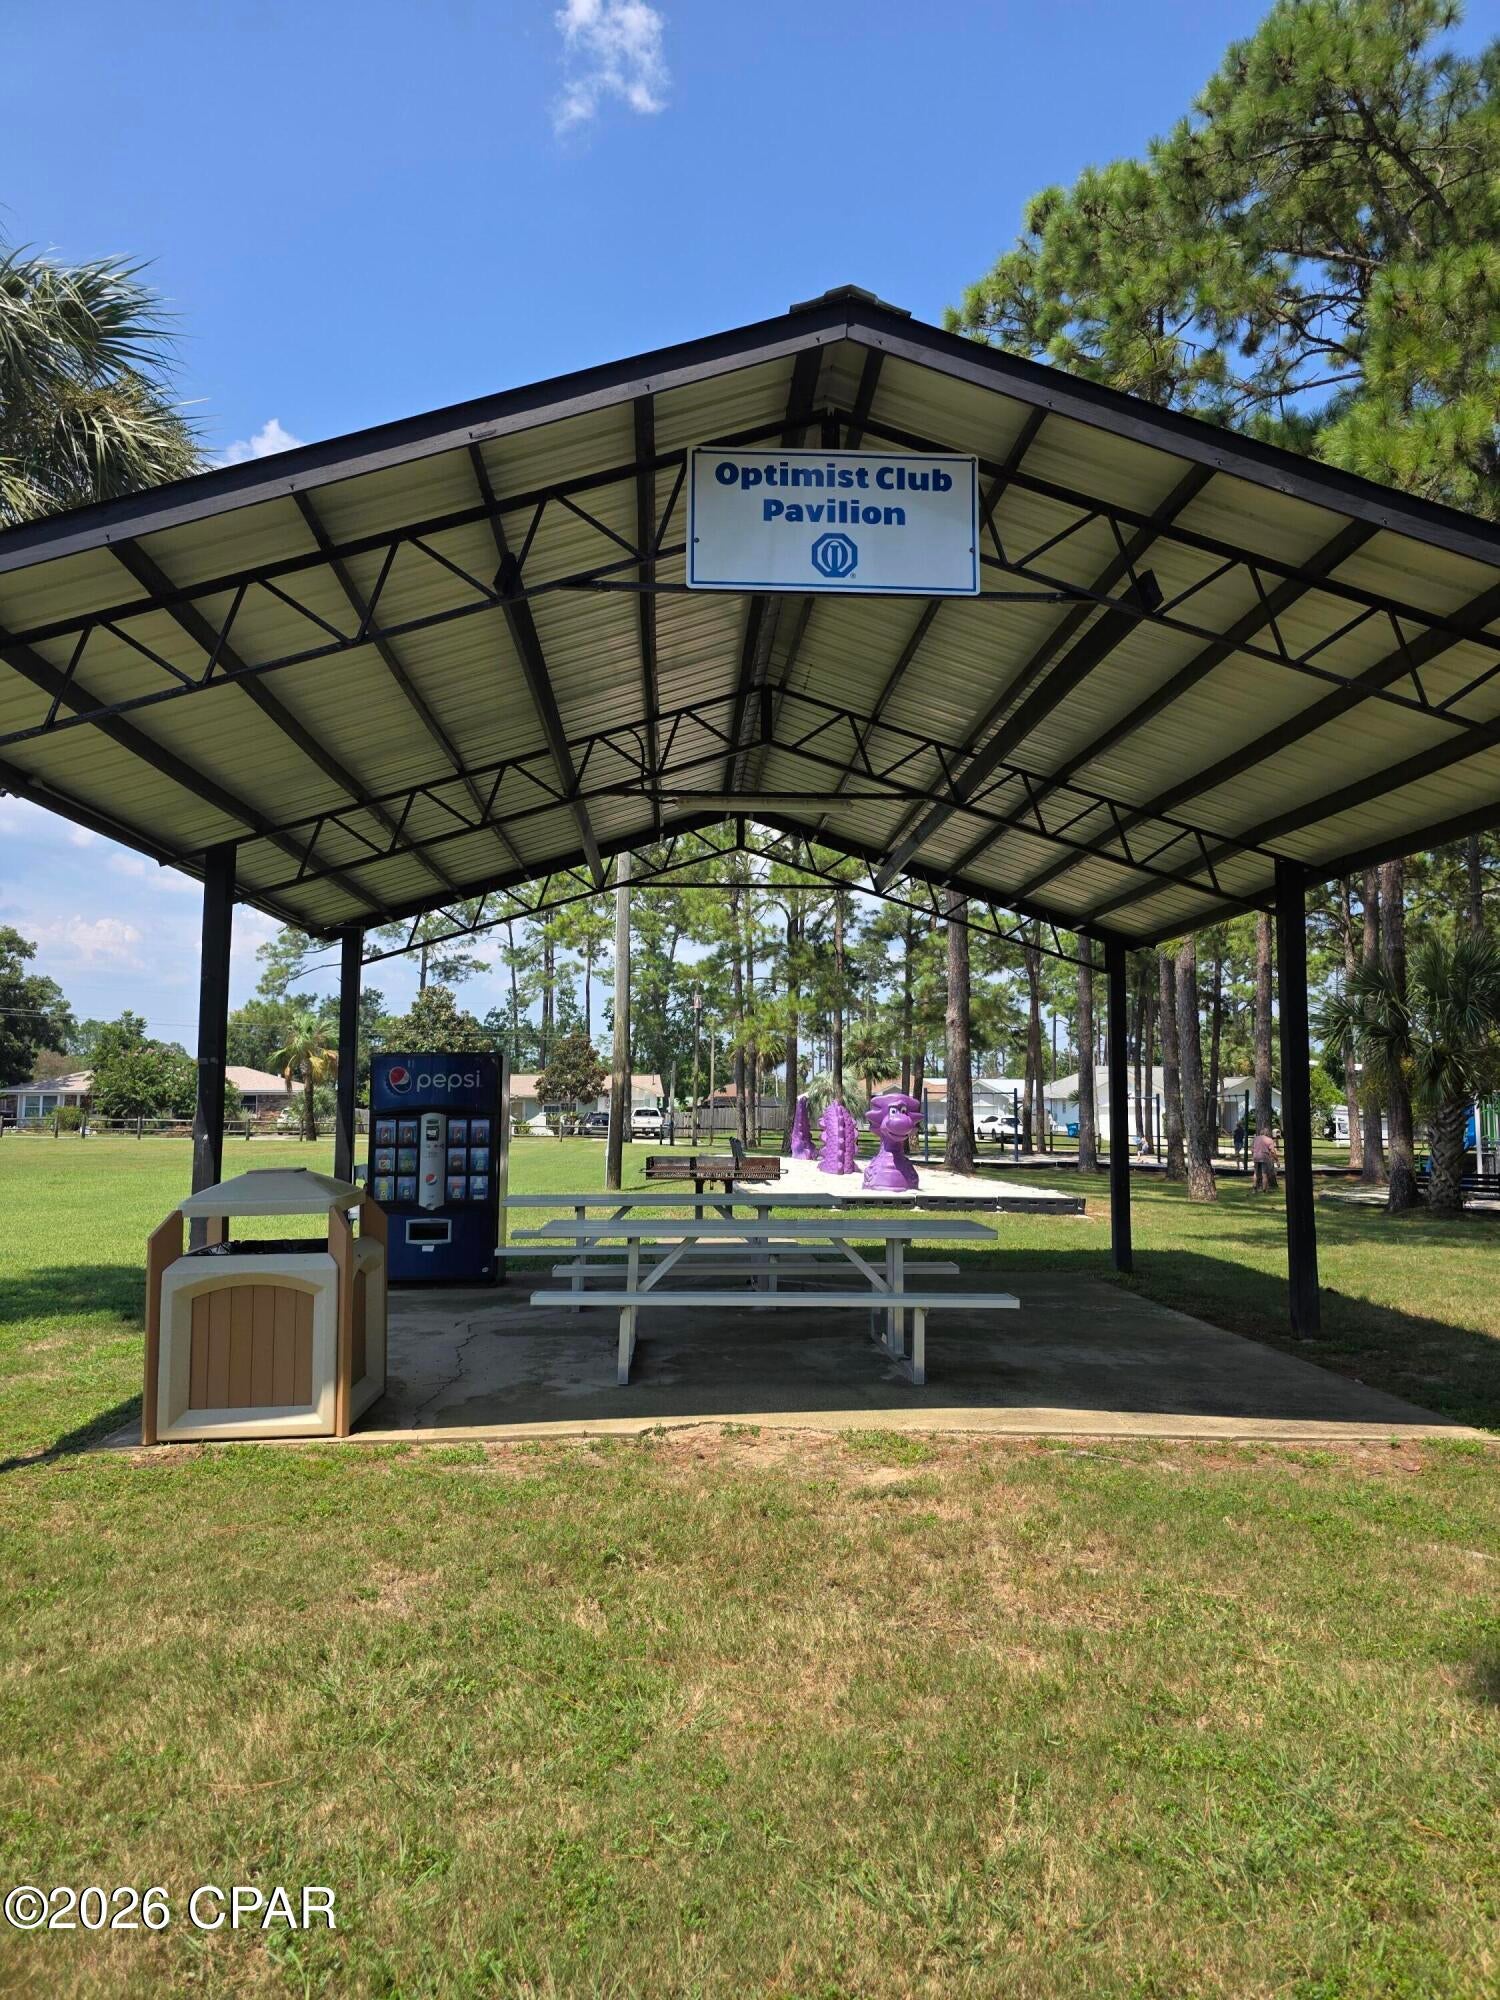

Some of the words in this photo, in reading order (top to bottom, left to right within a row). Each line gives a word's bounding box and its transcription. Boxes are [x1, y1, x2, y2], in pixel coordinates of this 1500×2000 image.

[715, 461, 869, 490] Optimist
[875, 466, 953, 492] Club
[763, 498, 905, 525] Pavilion
[416, 1070, 481, 1092] pepsi
